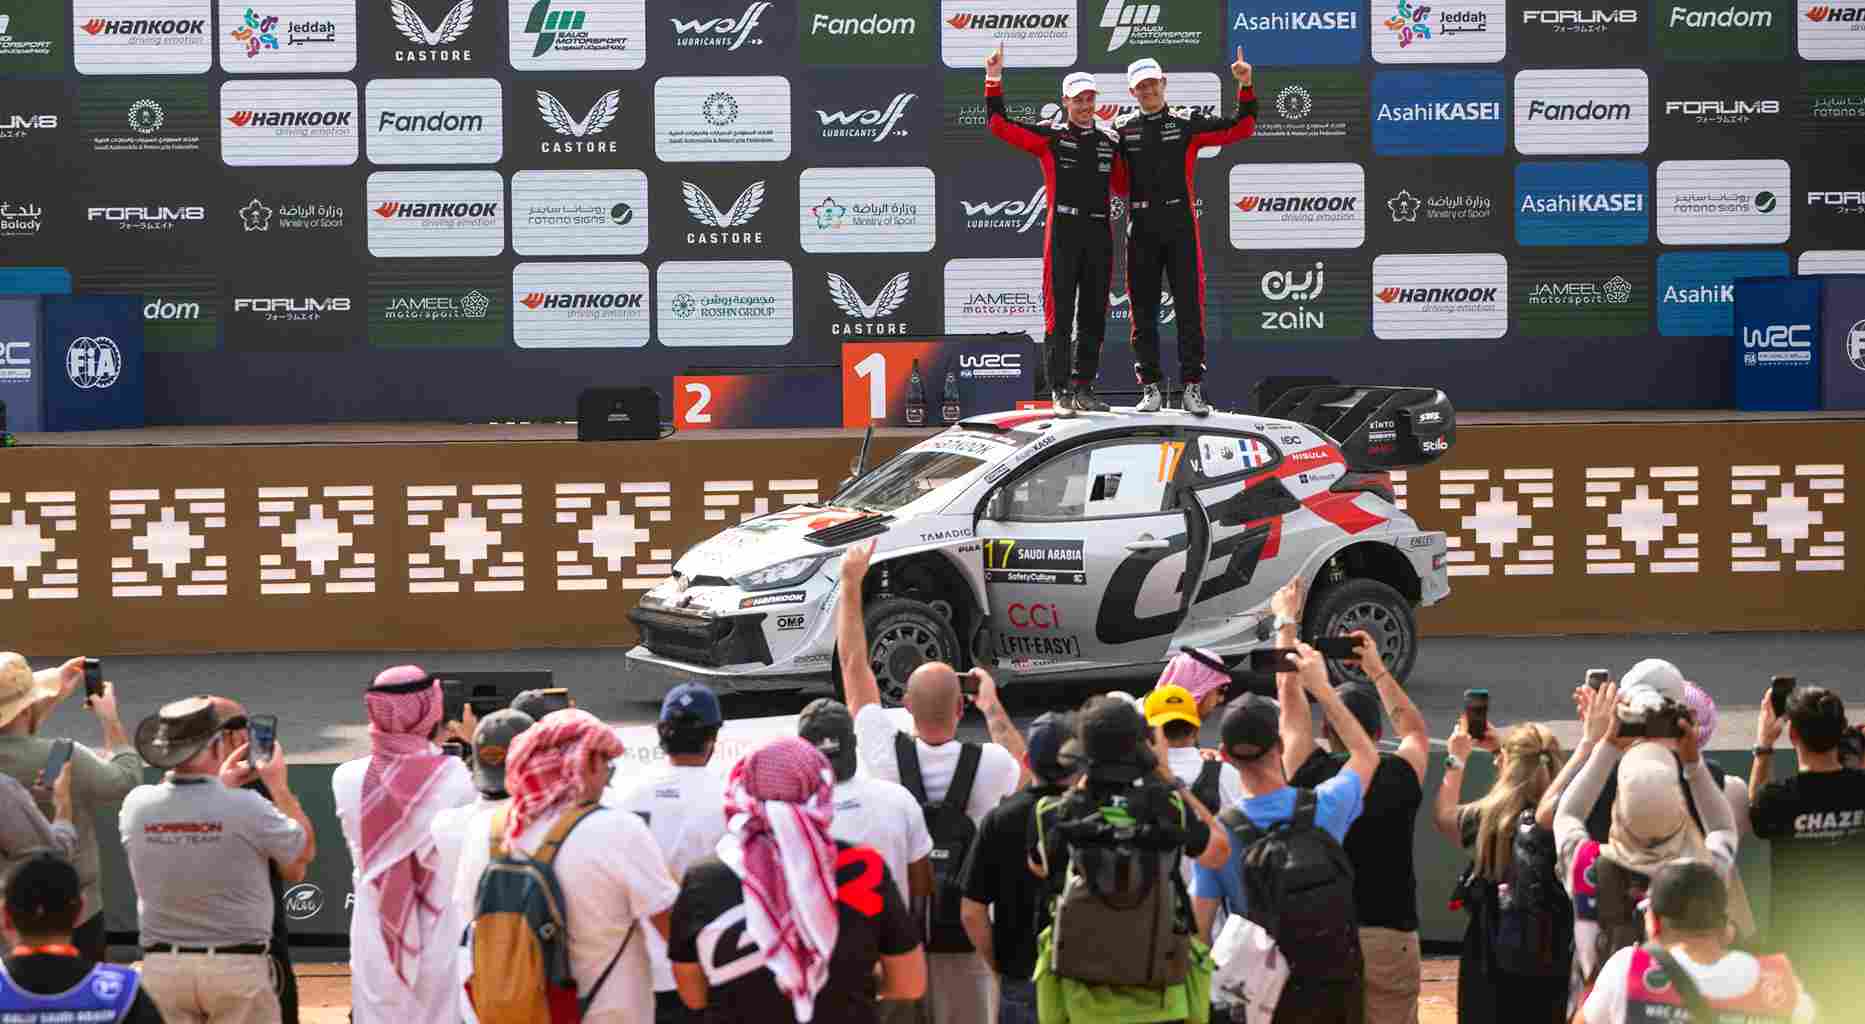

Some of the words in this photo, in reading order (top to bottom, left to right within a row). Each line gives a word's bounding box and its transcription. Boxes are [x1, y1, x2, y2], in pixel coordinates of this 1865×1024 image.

[1440, 10, 1486, 23] Jeddah
[1523, 10, 1638, 23] FORUM8
[1670, 7, 1772, 28] Fandom
[288, 21, 335, 33] Jeddah
[811, 14, 915, 35] Fandom
[128, 36, 164, 45] driving
[993, 30, 1027, 40] driving
[677, 37, 733, 46] LUBRICANTS
[395, 50, 472, 61] CASTORE
[1528, 100, 1630, 121] Fandom
[1666, 100, 1780, 114] FORUM8
[0, 115, 58, 129] UM8
[379, 110, 483, 133] Fandom
[959, 116, 986, 126] rota
[275, 128, 309, 137] driving
[823, 128, 877, 138] LUBRICANTS
[541, 141, 617, 153] CASTORE
[1808, 192, 1865, 205] FOR
[88, 206, 205, 221] FORUM8
[1281, 213, 1314, 222] driving
[1427, 209, 1457, 219] Ministry
[1468, 209, 1491, 218] Sport
[1, 219, 41, 232] Balady
[280, 218, 308, 228] Ministry
[320, 218, 343, 228] Sport
[422, 219, 454, 229] driving
[853, 217, 882, 226] Ministry
[893, 217, 916, 226] Sport
[967, 220, 1022, 229] LUBRICANTS
[687, 232, 763, 244] CASTORE
[1261, 262, 1324, 300] زين
[1529, 283, 1601, 296] JAMEEL
[1664, 285, 1734, 303] AsahiK
[234, 298, 351, 311] FORUM8
[385, 298, 454, 311] JAMEEL
[963, 293, 1031, 305] JAMEEL
[1529, 297, 1604, 306] motorsport
[144, 299, 199, 319] dom
[568, 309, 600, 319] driving
[700, 307, 738, 318] ROSHN
[739, 306, 776, 318] GROUP
[963, 304, 1043, 315] motorsport
[1422, 304, 1454, 313] driving
[385, 311, 460, 321] motorsport
[832, 323, 907, 335] CASTORE
[854, 352, 886, 418] 1
[684, 383, 711, 423] 2
[1159, 441, 1184, 480] 17
[920, 529, 972, 542] TAMADIC
[985, 540, 1016, 568] 17
[1018, 549, 1045, 560] SAUDI
[1048, 550, 1081, 560] ARABIA
[777, 616, 804, 627] OMP
